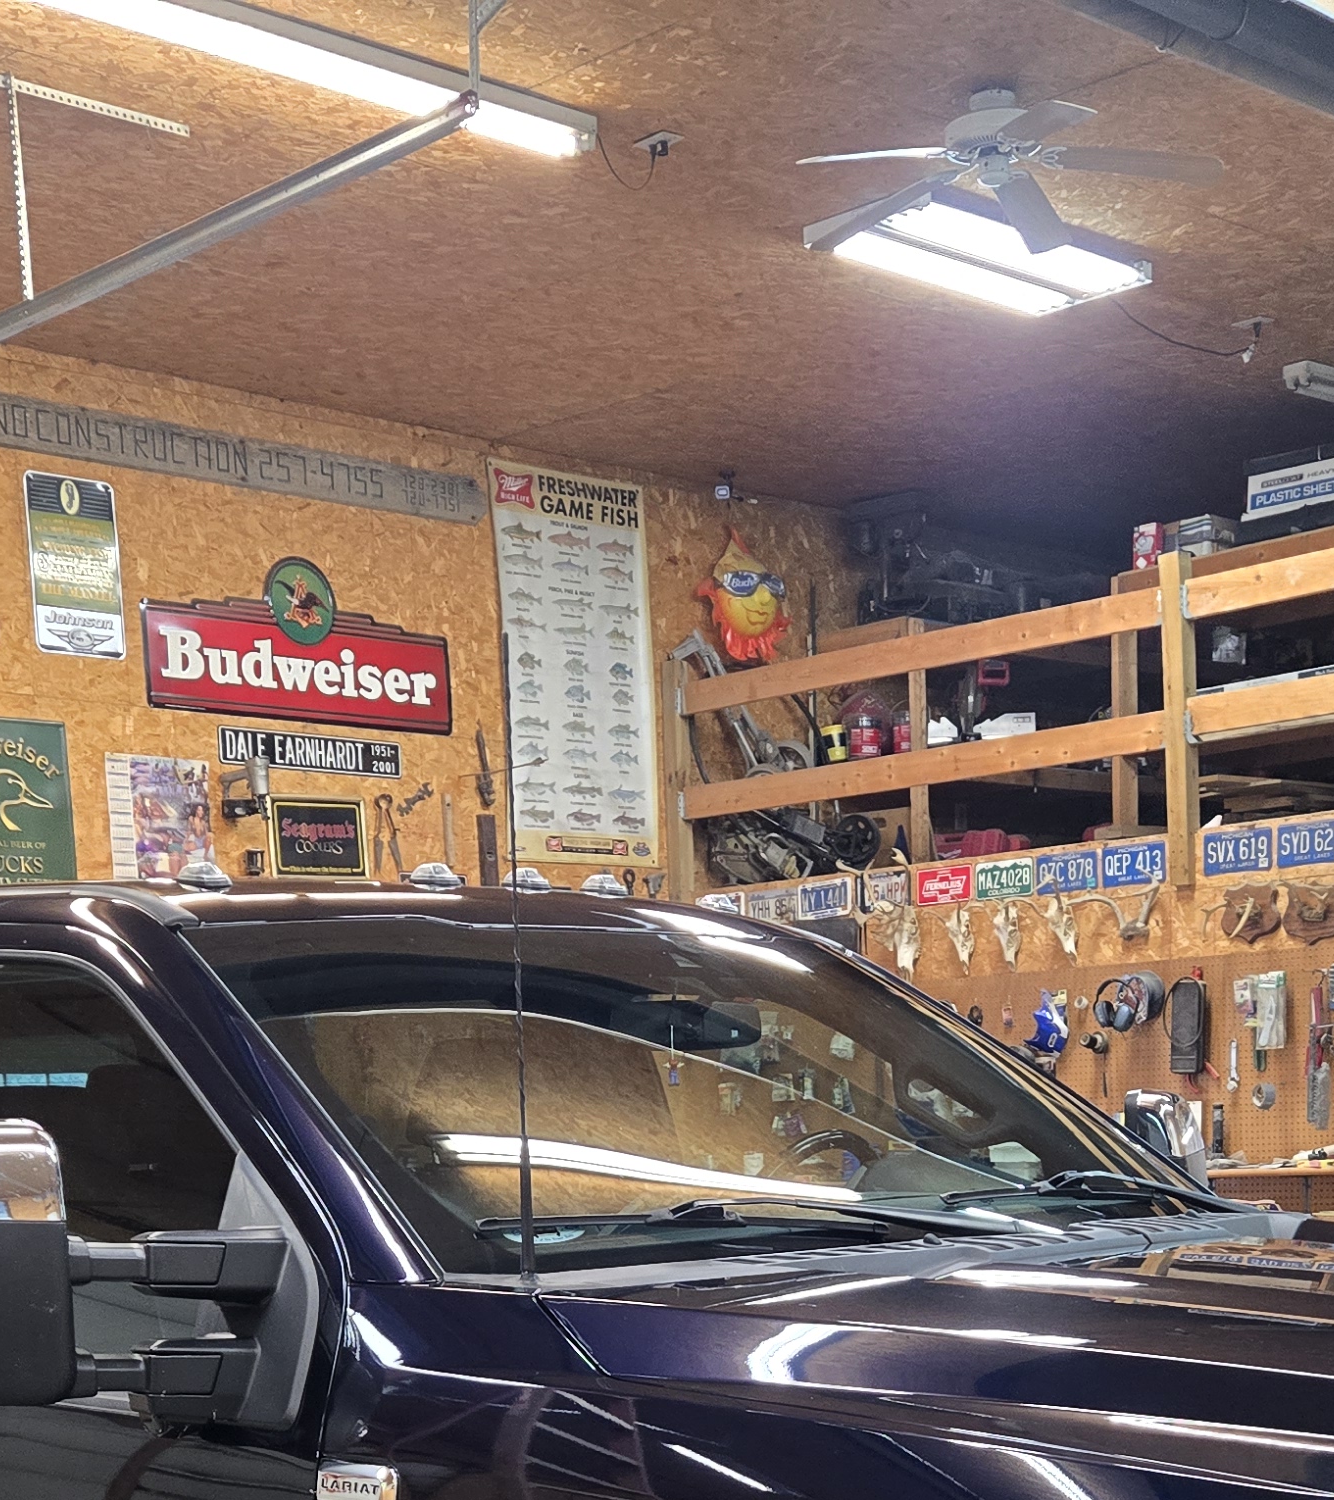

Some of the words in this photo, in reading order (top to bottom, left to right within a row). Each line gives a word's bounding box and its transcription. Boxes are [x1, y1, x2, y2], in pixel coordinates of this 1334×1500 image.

[537, 475, 638, 509] FRESHWATER
[1255, 486, 1301, 507] PLASTIC
[540, 495, 594, 521] GAME
[601, 506, 639, 529] FISH
[45, 610, 113, 631] Johnson
[159, 626, 437, 706] Budweiser
[275, 735, 364, 772] EARNHARDT
[372, 761, 396, 773] 2001
[281, 818, 356, 841] Seagram's
[1296, 822, 1330, 830] MICHIGAN
[295, 840, 343, 855] COOLERS
[1207, 839, 1235, 864] SVX
[1239, 836, 1268, 859] 619
[1280, 831, 1310, 855] SYD
[1068, 857, 1093, 880] 878
[1105, 853, 1130, 877] QEP
[1135, 849, 1162, 872] 413
[987, 887, 1021, 896] COLORADO
[321, 1477, 380, 1496] LARIAT
